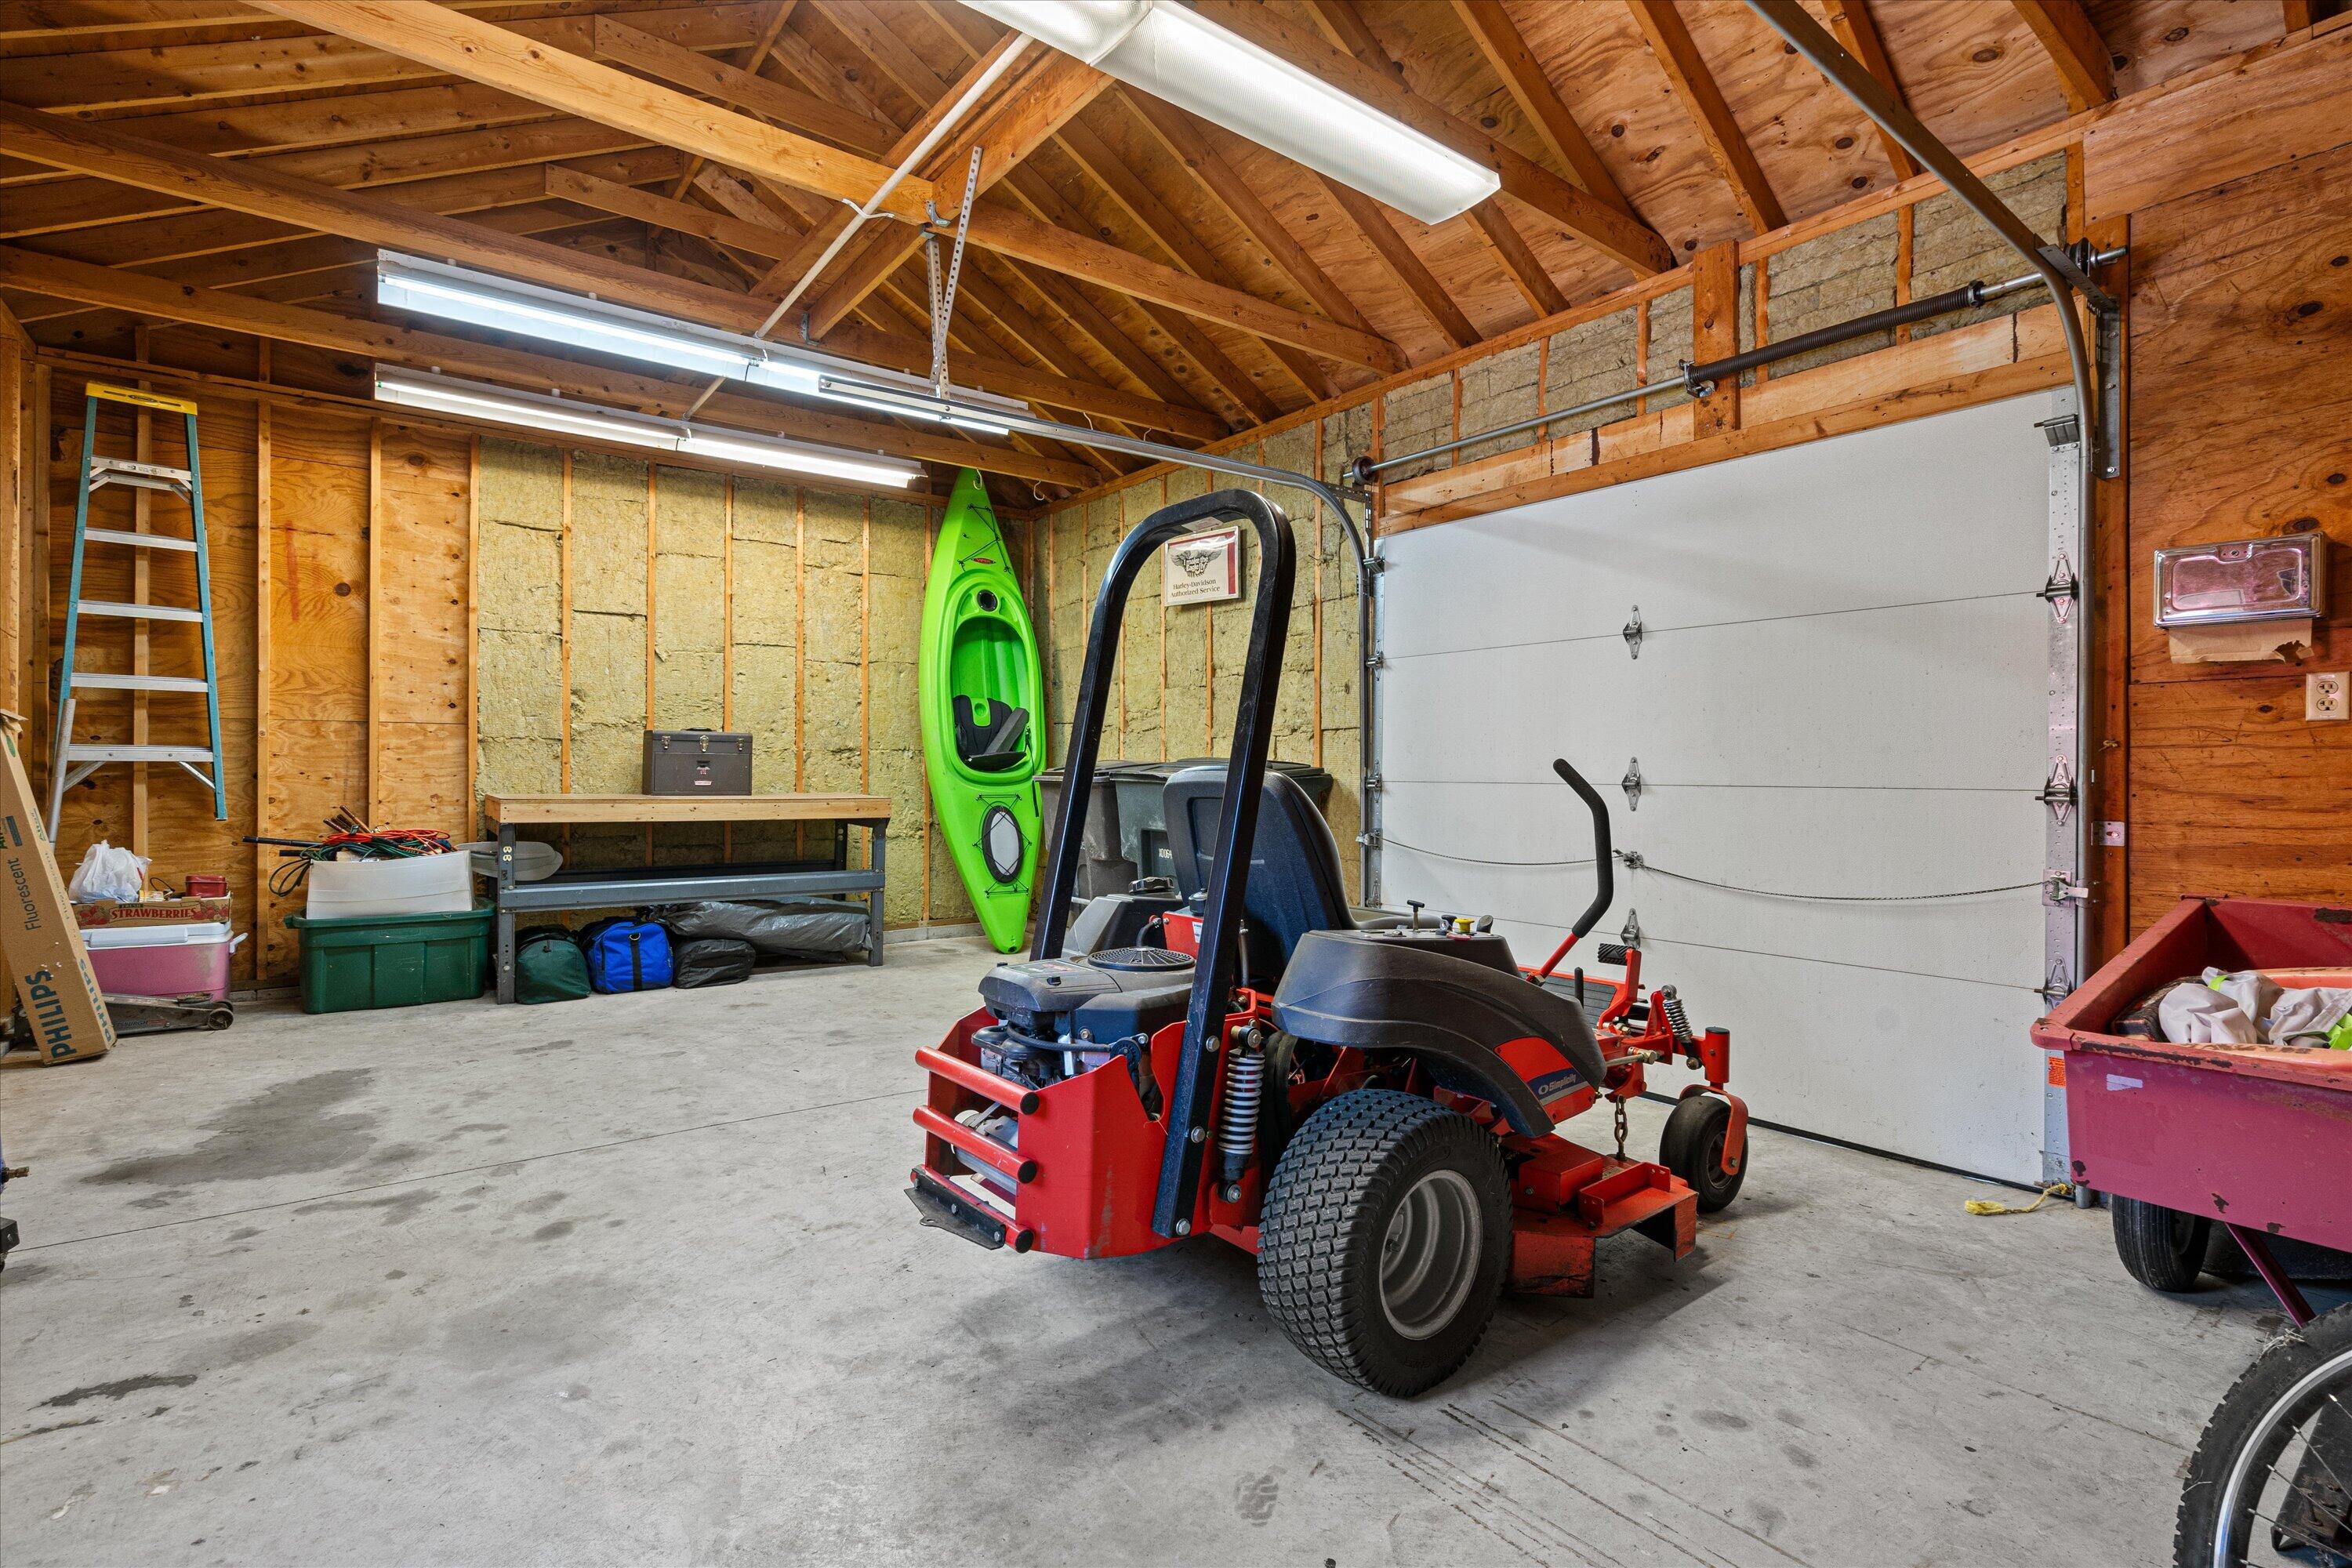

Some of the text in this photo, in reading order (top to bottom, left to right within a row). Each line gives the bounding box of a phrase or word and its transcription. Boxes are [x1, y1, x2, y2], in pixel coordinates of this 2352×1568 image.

[1171, 586, 1221, 597] Authorized Service
[1173, 579, 1217, 590] Harley-Davidson
[7, 856, 42, 931] Fluorescent
[111, 906, 196, 920] STRAWBERRIES
[25, 969, 77, 1059] PHILIPS
[1548, 1073, 1577, 1091] Simplicity
